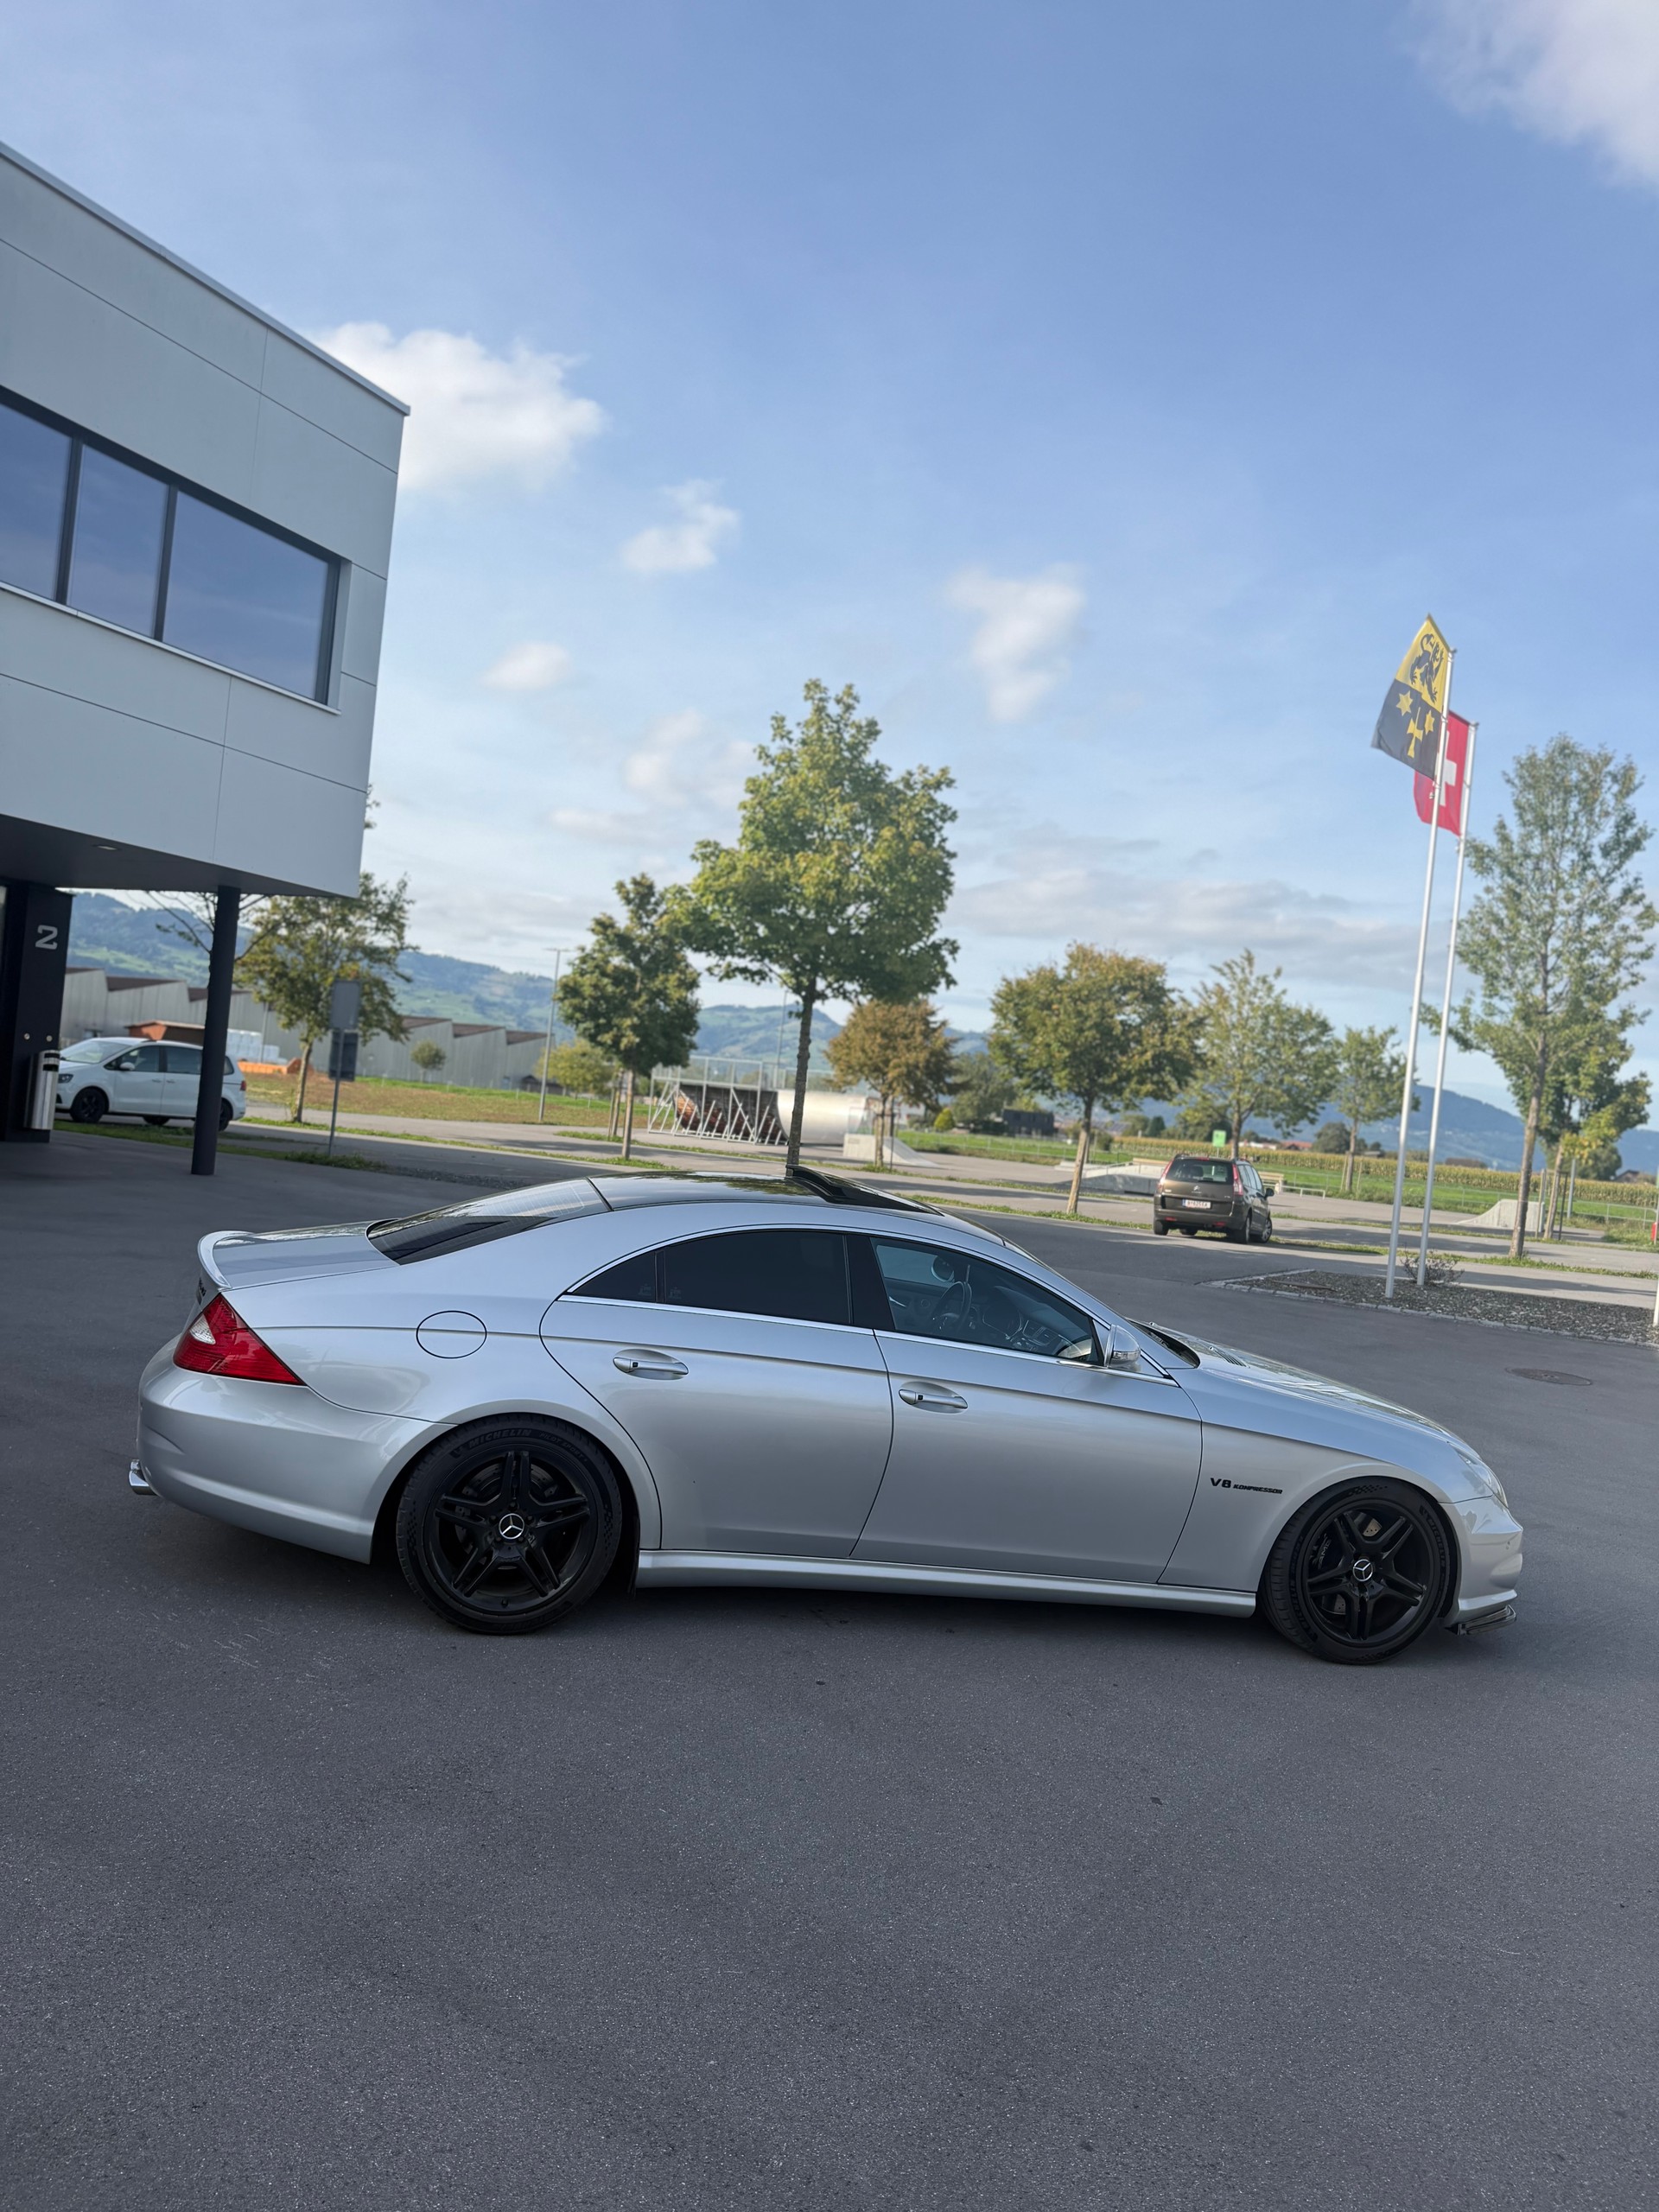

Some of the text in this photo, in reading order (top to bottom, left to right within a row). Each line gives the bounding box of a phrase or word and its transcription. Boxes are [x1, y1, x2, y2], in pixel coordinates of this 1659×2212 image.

[35, 925, 58, 950] 2
[468, 1429, 531, 1449] MICHELIN
[539, 1432, 561, 1444] PILOT
[1211, 1478, 1282, 1494] V8 KOMPRESSOR
[1427, 1518, 1446, 1567] MICHELIN
